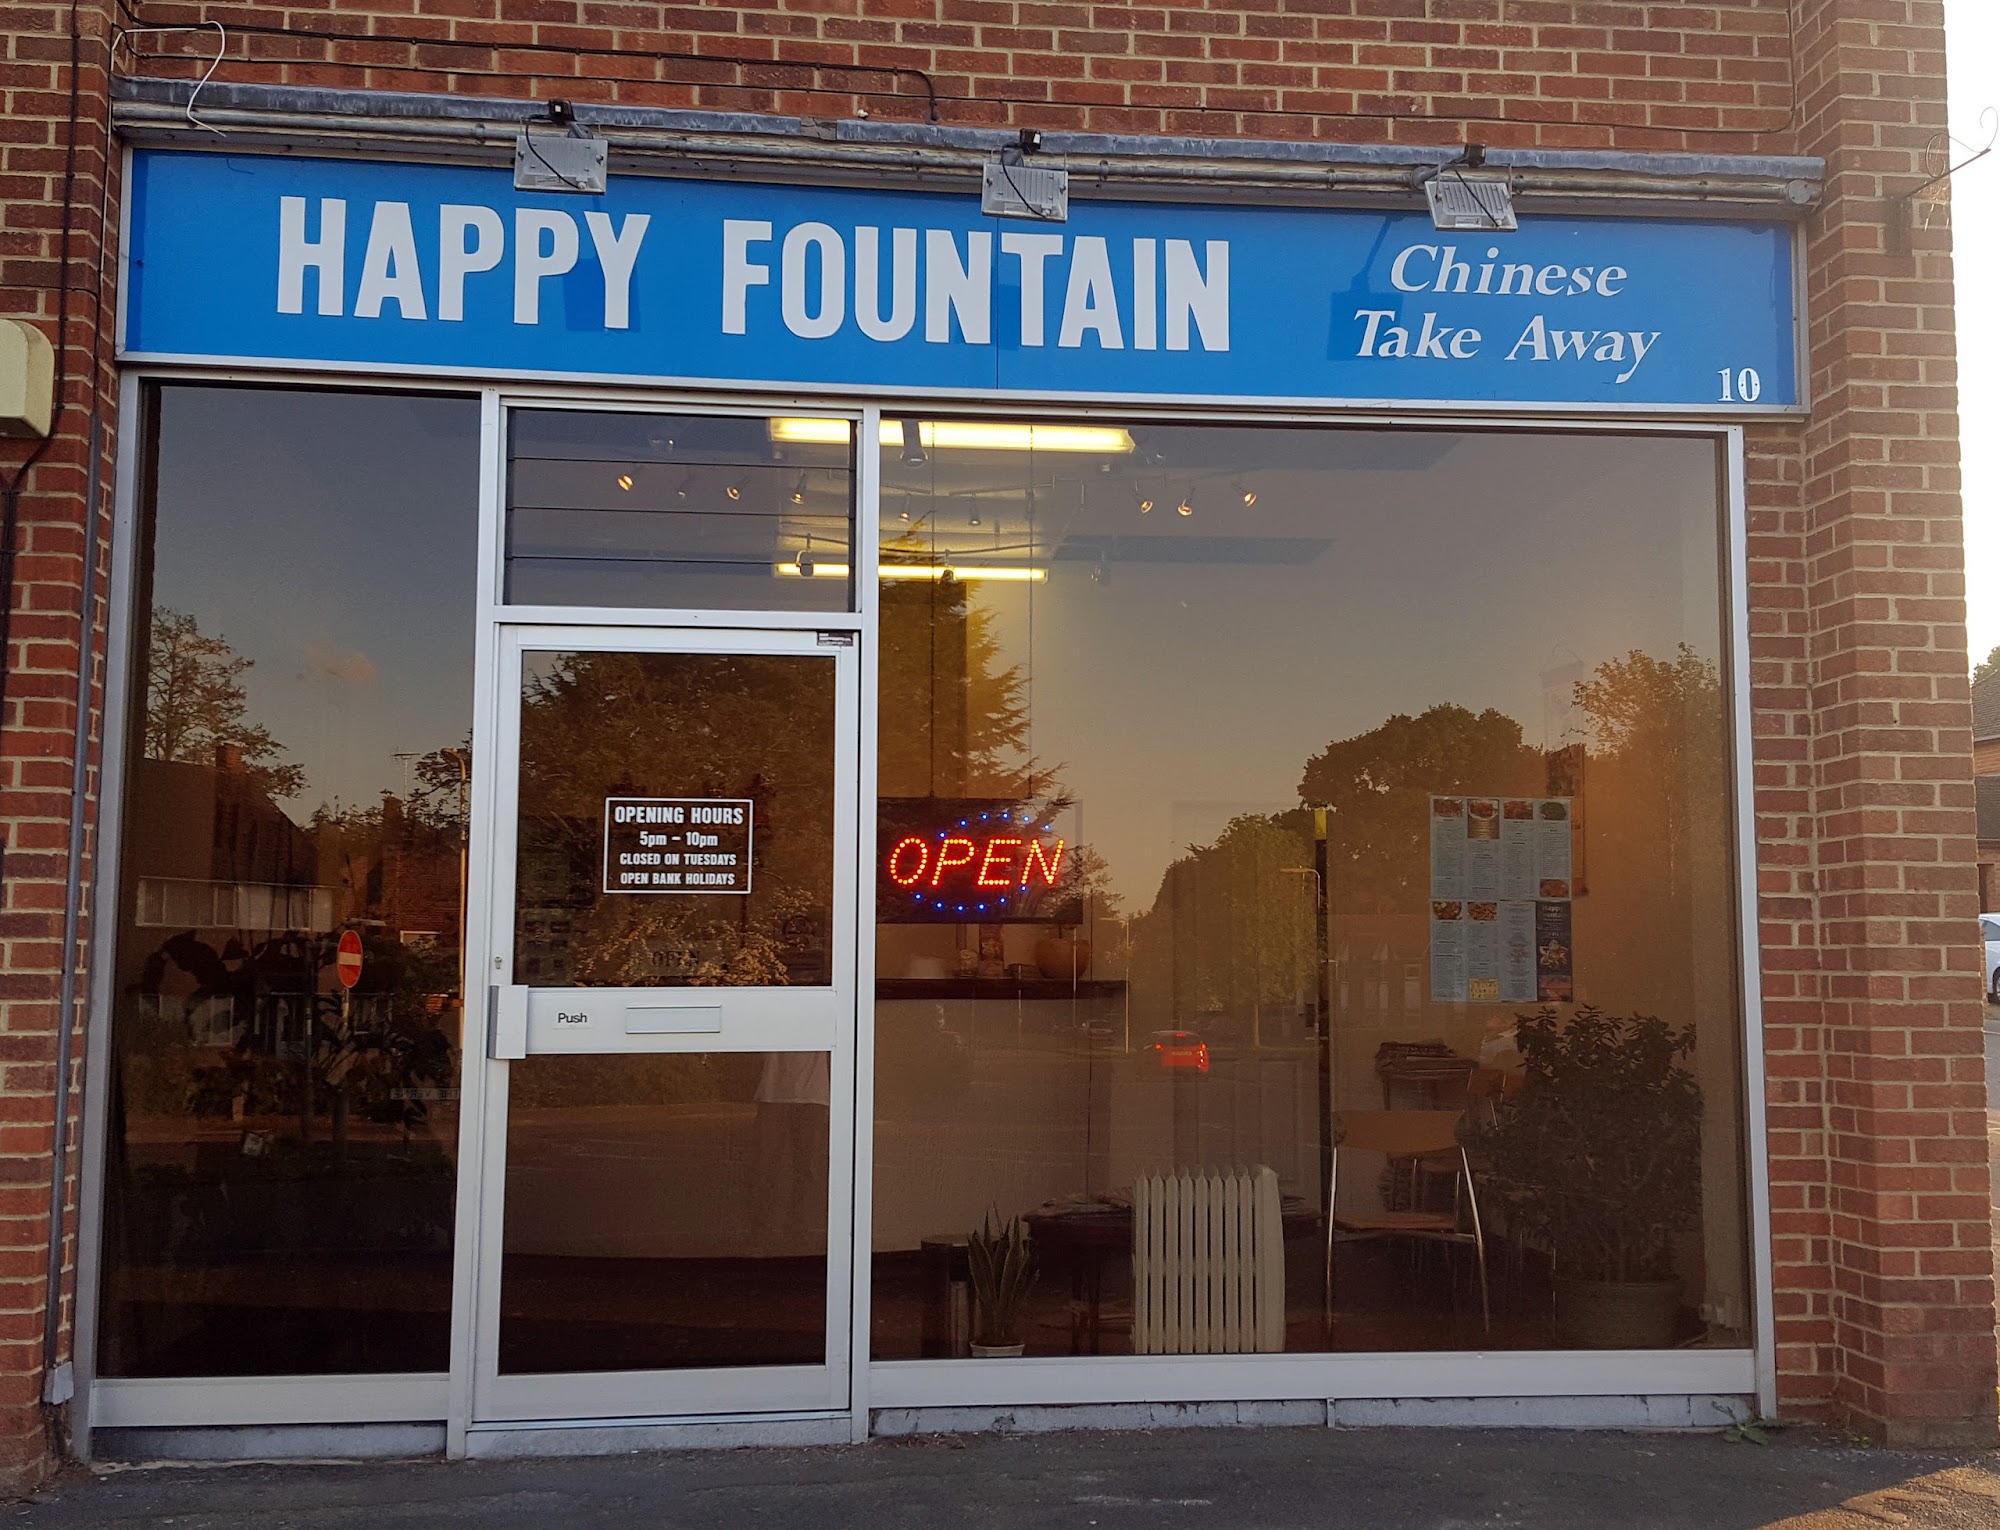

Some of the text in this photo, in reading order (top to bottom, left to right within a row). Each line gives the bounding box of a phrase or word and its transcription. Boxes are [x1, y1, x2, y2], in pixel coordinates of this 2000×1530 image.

[277, 195, 1230, 352] HAPPY FOUNTAIN
[1390, 244, 1628, 297] Chinese
[1354, 309, 1662, 384] Take Away
[1717, 367, 1761, 402] 10
[614, 806, 744, 825] OPENING HOURS
[639, 830, 667, 848] 5pm
[685, 831, 718, 848] 10pm
[619, 852, 737, 866] CLOSED ON TUESDAYS
[889, 837, 1066, 887] OPEN
[620, 872, 735, 886] OPEN BANK HOLIDAYS
[557, 1012, 588, 1024] Push
